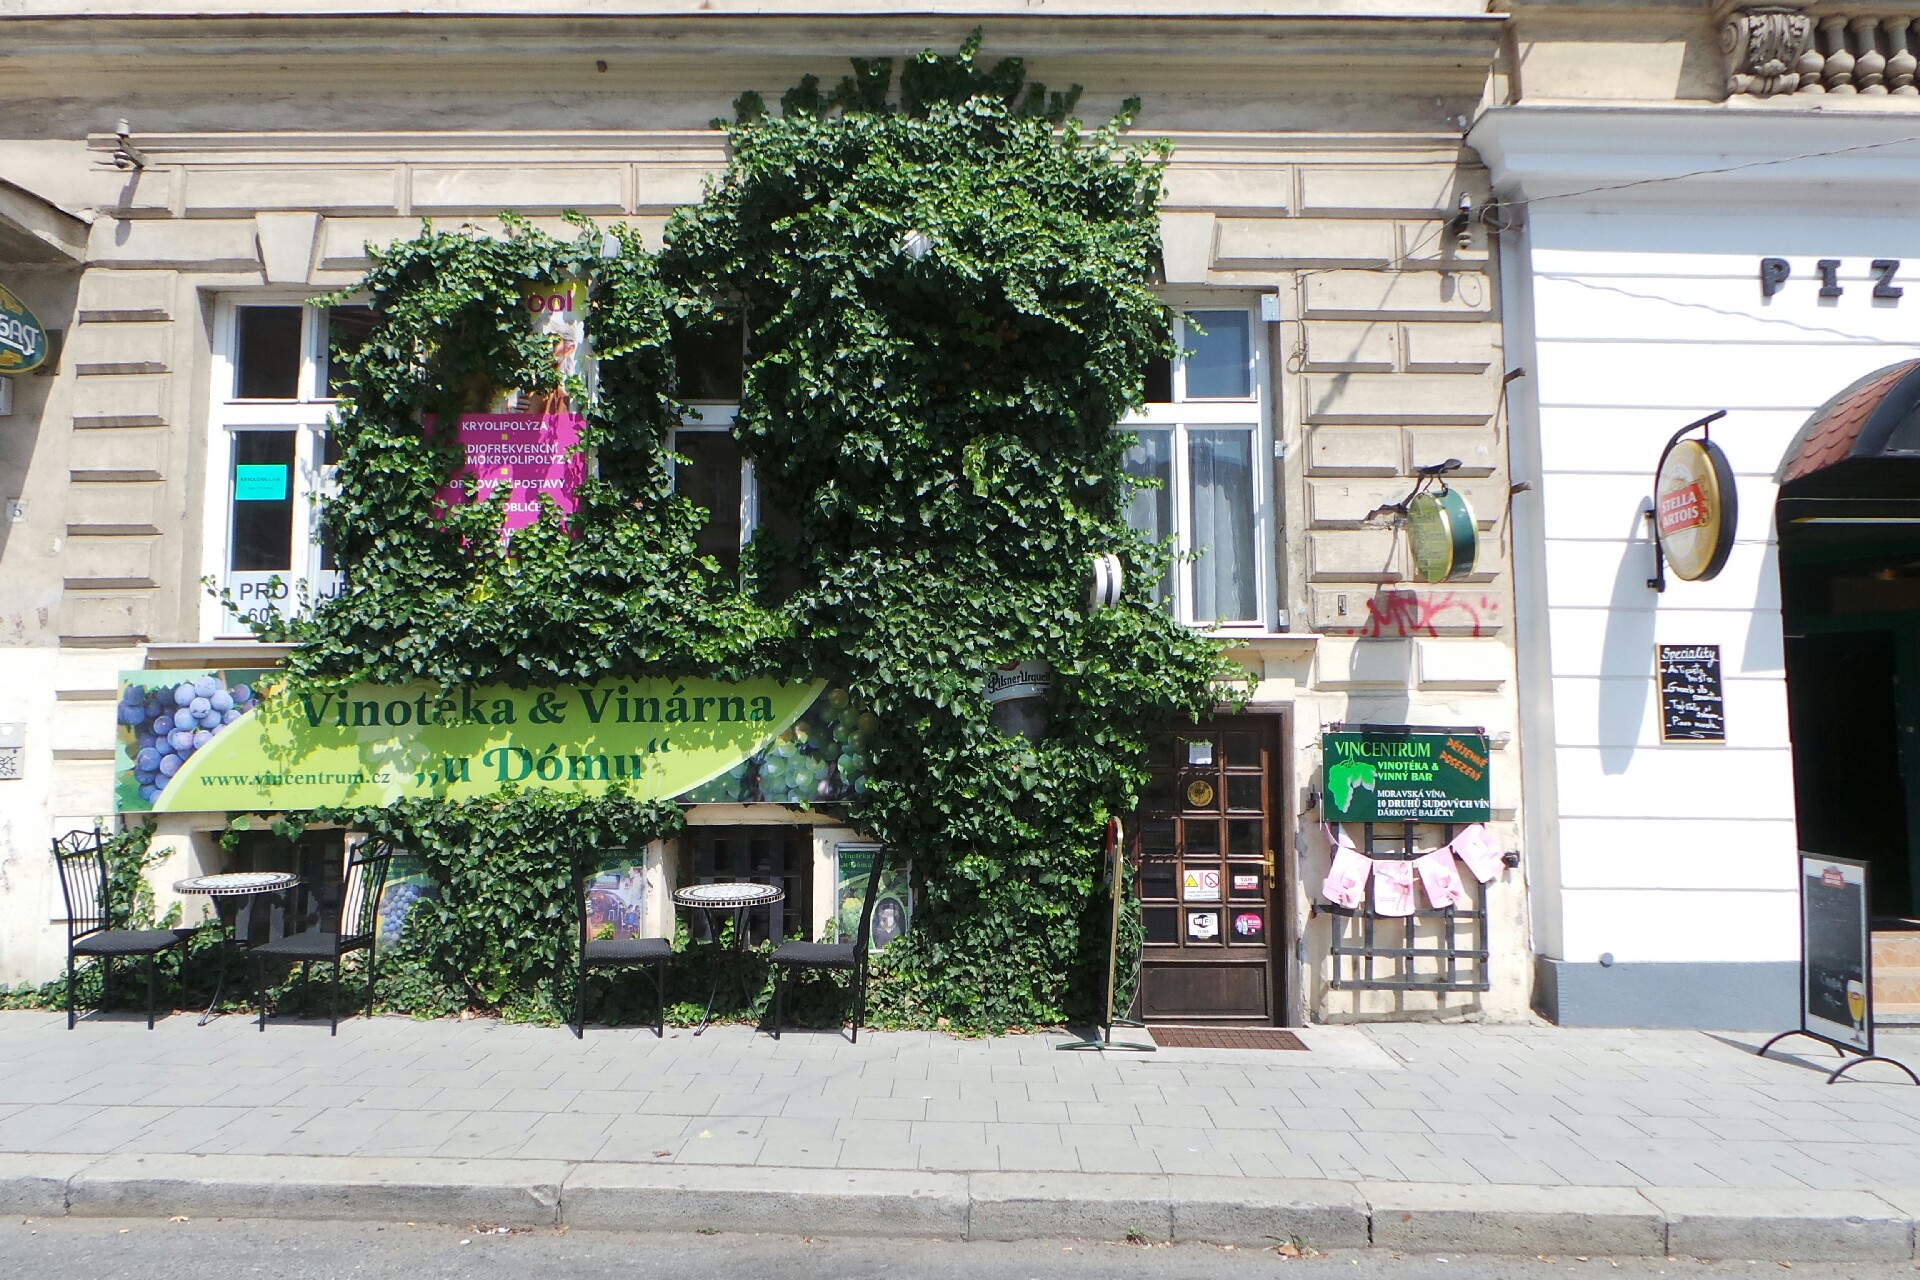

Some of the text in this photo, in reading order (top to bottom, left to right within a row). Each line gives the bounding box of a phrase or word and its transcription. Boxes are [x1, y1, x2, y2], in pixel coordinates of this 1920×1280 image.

[1761, 258, 1903, 298] PIZ
[462, 420, 548, 431] KRYOLIPOLÝZA
[514, 479, 565, 489] POSTAVY
[1662, 491, 1697, 513] STELLA
[1662, 506, 1699, 529] ARTOIS
[987, 671, 1021, 694] Pilsner
[298, 685, 776, 728] Vinotéka & Vinárna
[1335, 741, 1431, 758] VINCENTRUM
[1377, 759, 1440, 771] VINOTÉKA &
[200, 770, 391, 787] www.vincentrum.cz
[1377, 770, 1433, 781] VINNÝ BAR
[1377, 788, 1446, 798] MORAVSKÁ VÍNA
[1377, 799, 1388, 808] 10
[1389, 797, 1420, 808] DRUHŮ
[1422, 797, 1472, 808] SUDOVÝCH
[1377, 807, 1456, 817] DÁRKOVÉ BALÍČKY
